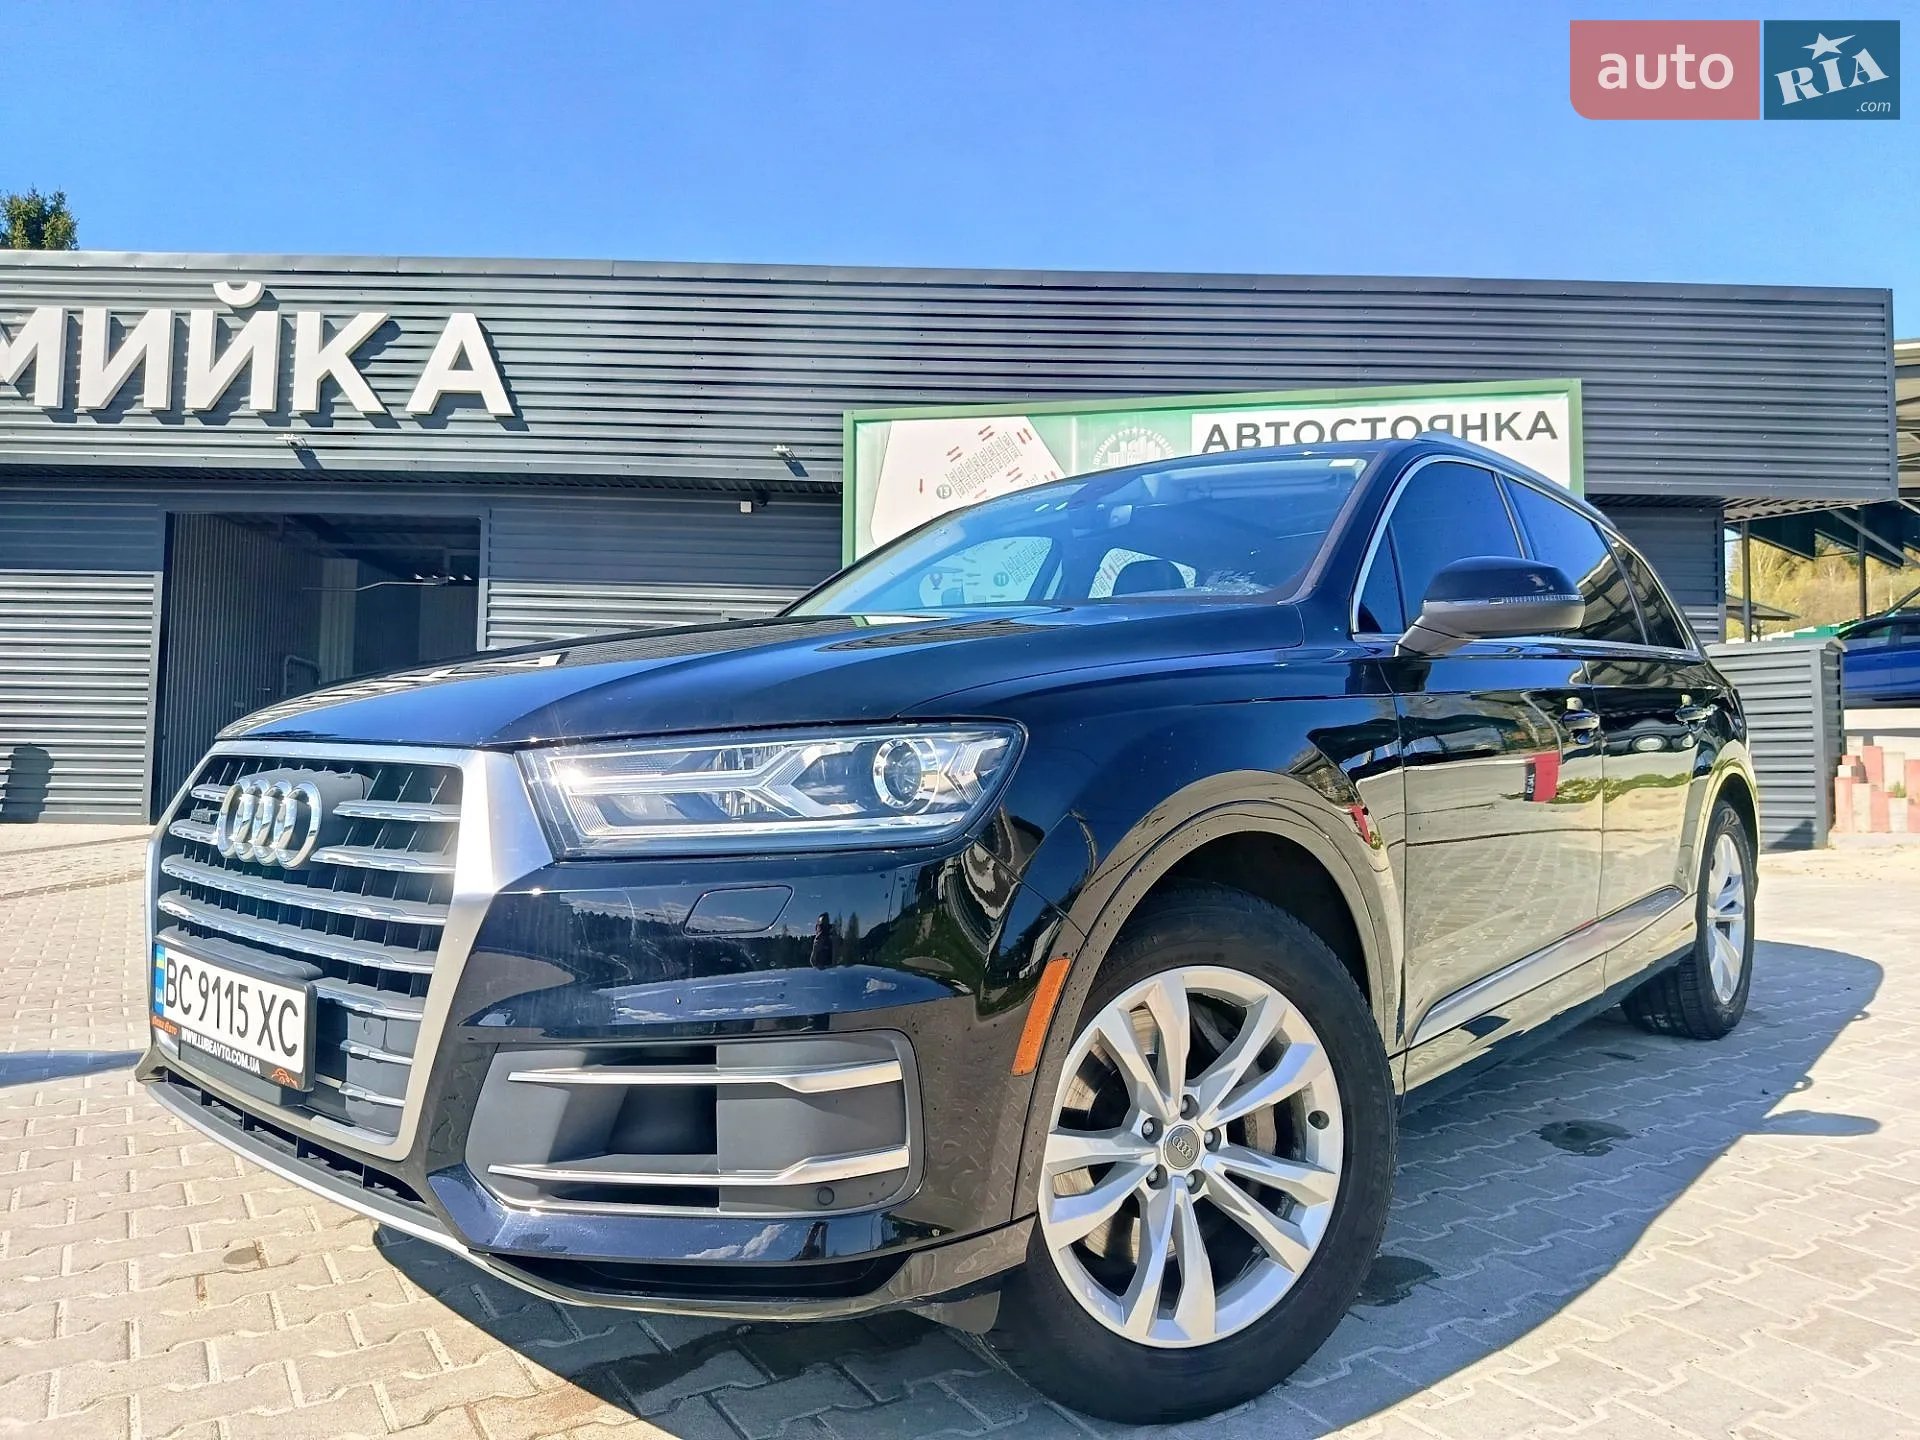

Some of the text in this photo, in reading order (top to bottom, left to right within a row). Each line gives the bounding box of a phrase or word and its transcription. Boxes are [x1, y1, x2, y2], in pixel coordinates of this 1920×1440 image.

[1202, 410, 1558, 453] АВТОСТОЯНКА
[165, 957, 299, 1057] BC 9115 XC
